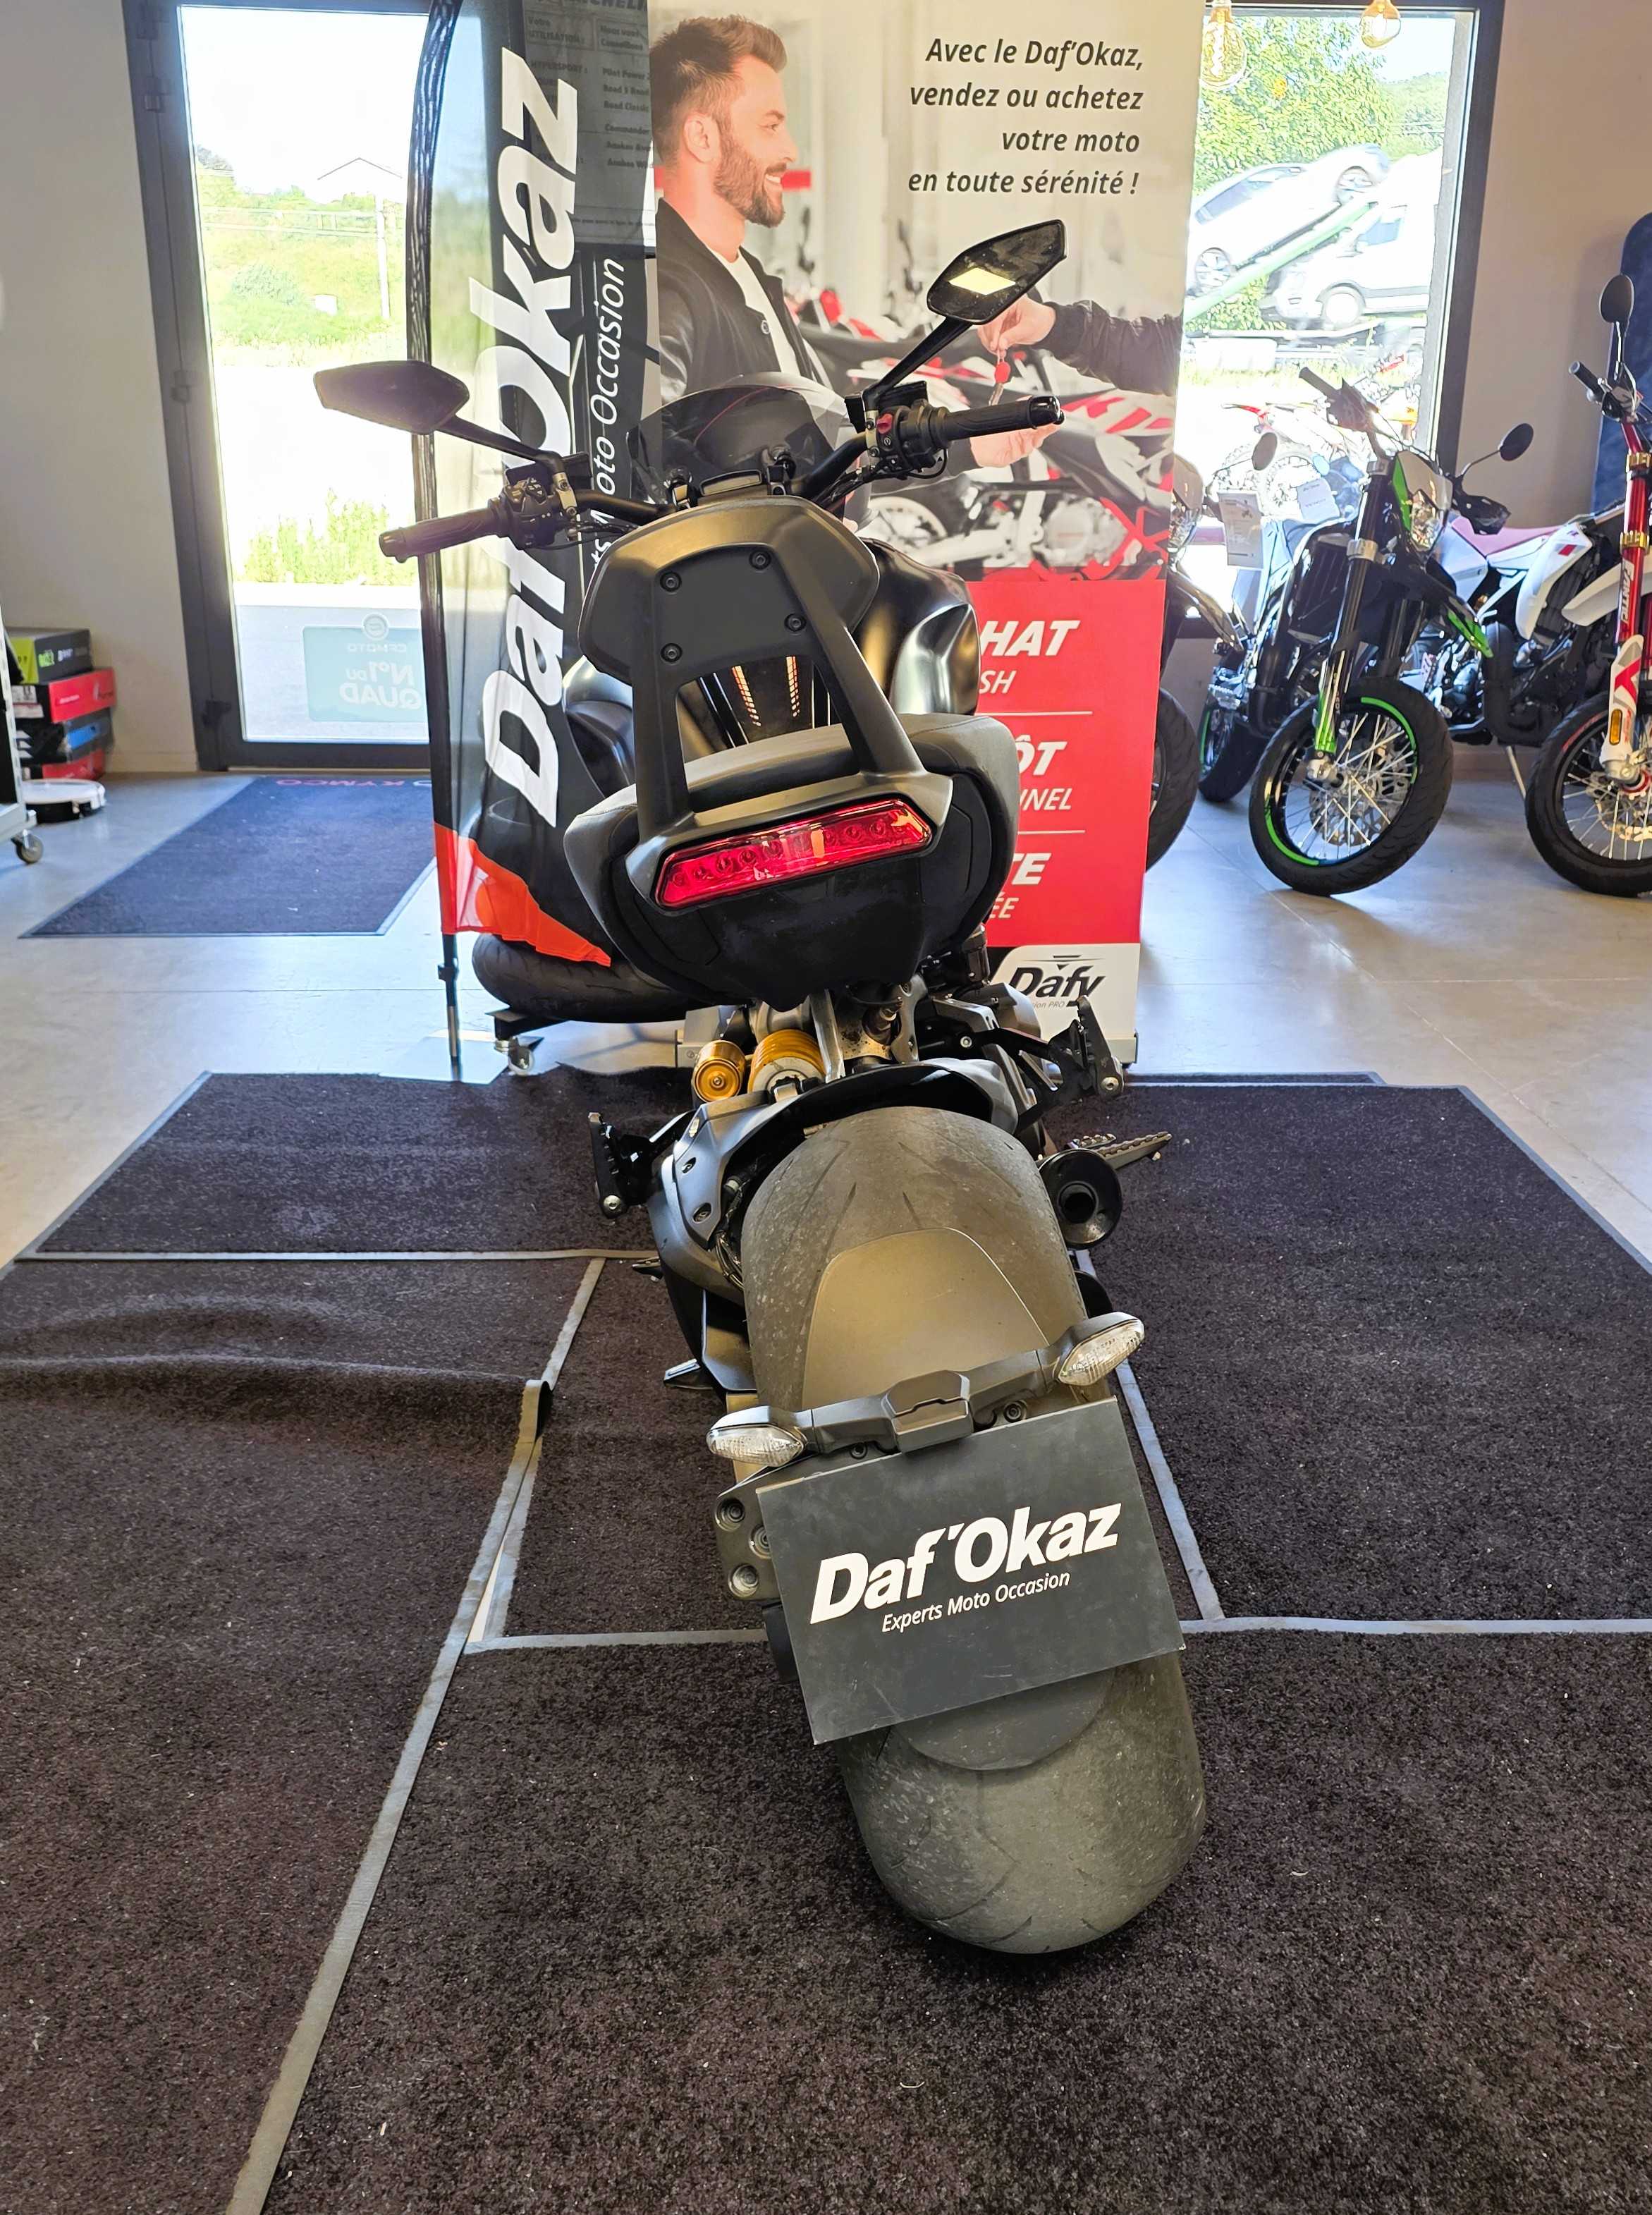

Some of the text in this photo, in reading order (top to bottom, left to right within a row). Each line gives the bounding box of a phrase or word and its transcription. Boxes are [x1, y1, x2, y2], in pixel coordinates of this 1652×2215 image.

[925, 38, 1143, 72] Avec le Daf'Okaz,
[910, 82, 1144, 110] vendez ou achetez
[1003, 129, 1139, 153] votre moto
[908, 173, 937, 192] en
[946, 171, 1015, 193] toute
[1021, 169, 1123, 195] sérénité
[590, 258, 625, 425] Occasion
[1009, 964, 1106, 1007] Dafy
[1048, 1000, 1065, 1009] PRO
[809, 1502, 1122, 1625] Daf'Okaz
[881, 1570, 1070, 1633] Experts Moto Occasion
